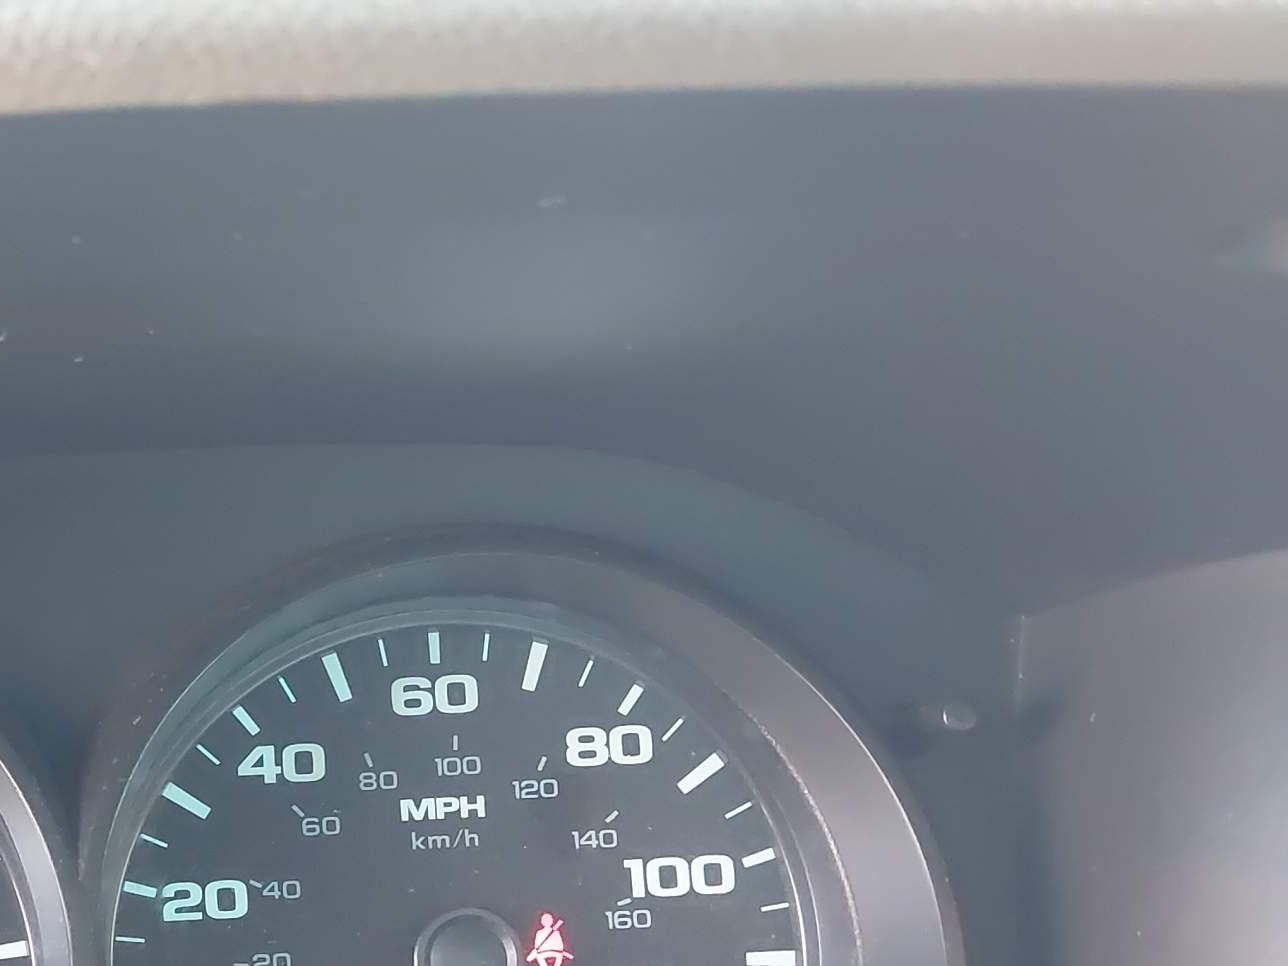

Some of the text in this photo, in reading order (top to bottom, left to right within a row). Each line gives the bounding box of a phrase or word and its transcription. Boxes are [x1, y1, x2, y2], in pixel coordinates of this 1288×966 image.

[390, 673, 479, 717] 60
[565, 724, 653, 768] 80
[237, 744, 325, 783] 40
[434, 756, 482, 777] 100
[358, 770, 398, 792] 80
[511, 778, 559, 800] 120
[399, 796, 487, 822] MPH
[301, 817, 341, 837] 60
[411, 829, 480, 851] km/h
[571, 829, 619, 850] 140
[623, 855, 736, 898] 100
[161, 880, 249, 922] 20
[261, 880, 302, 900] 40
[605, 910, 653, 931] 160
